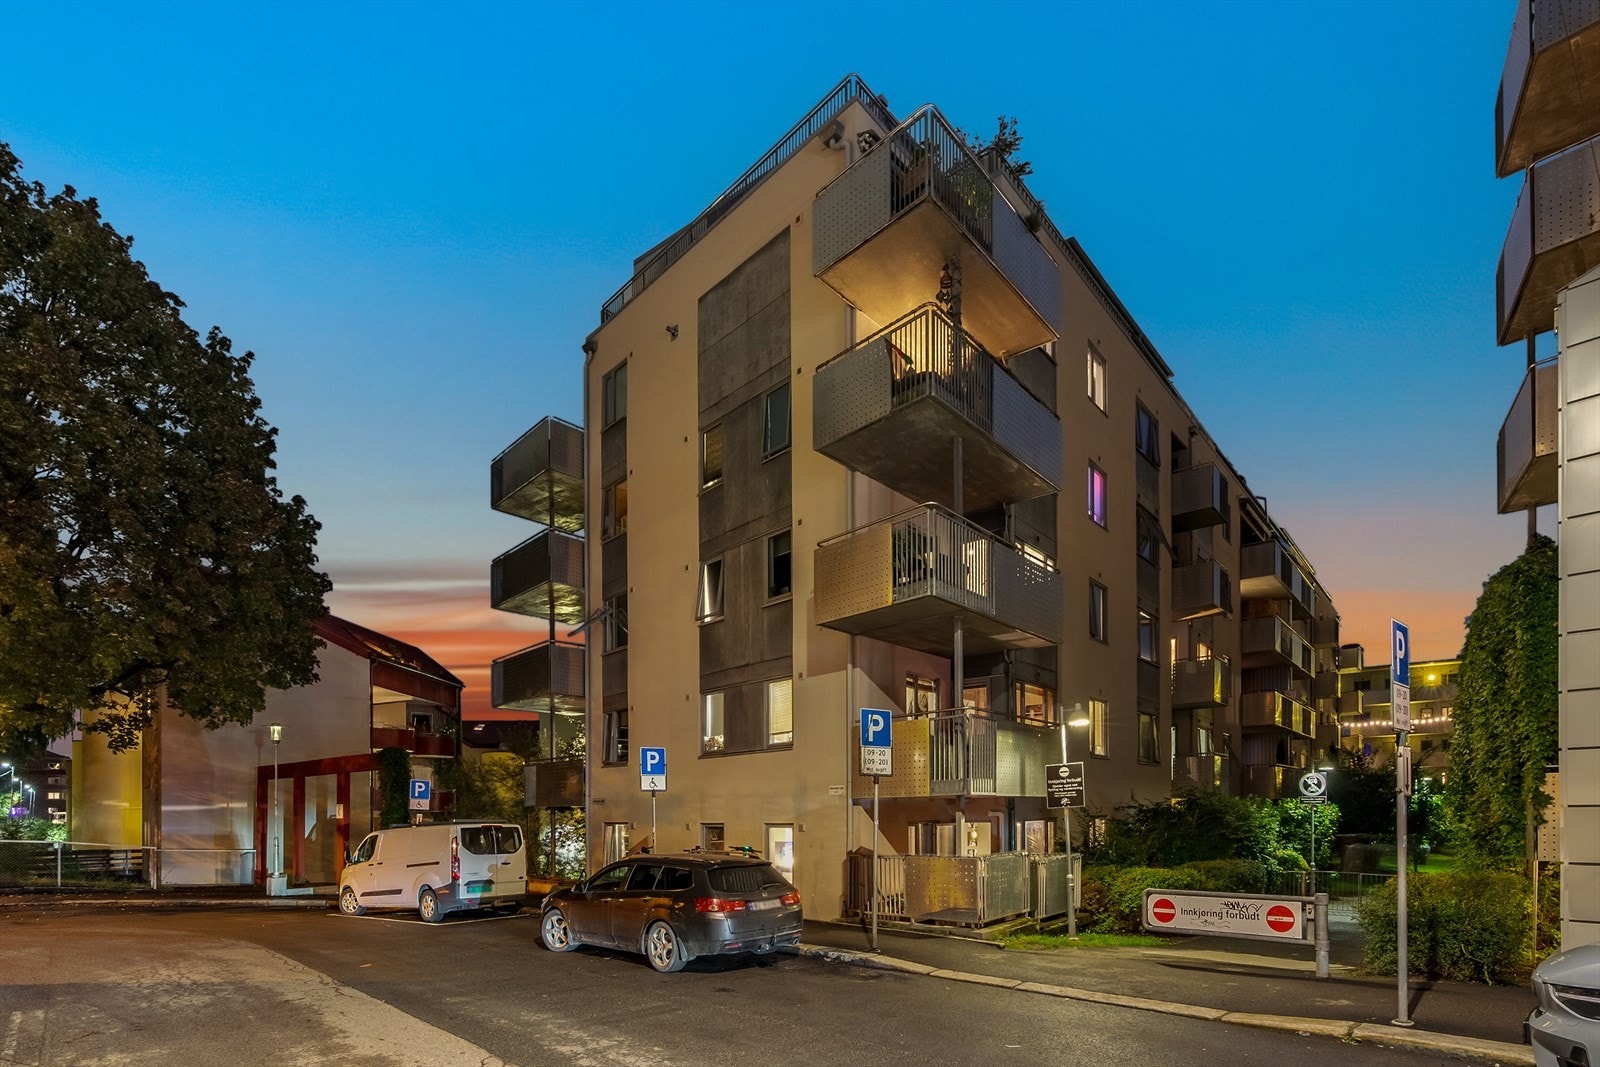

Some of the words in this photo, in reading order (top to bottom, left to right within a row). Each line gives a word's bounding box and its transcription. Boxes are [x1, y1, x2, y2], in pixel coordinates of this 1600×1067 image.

[1396, 630, 1405, 675] P
[868, 714, 884, 742] P
[646, 751, 660, 772] P
[415, 782, 426, 797] P
[1180, 907, 1223, 921] Innkjøring
[1226, 910, 1261, 921] forbudt
